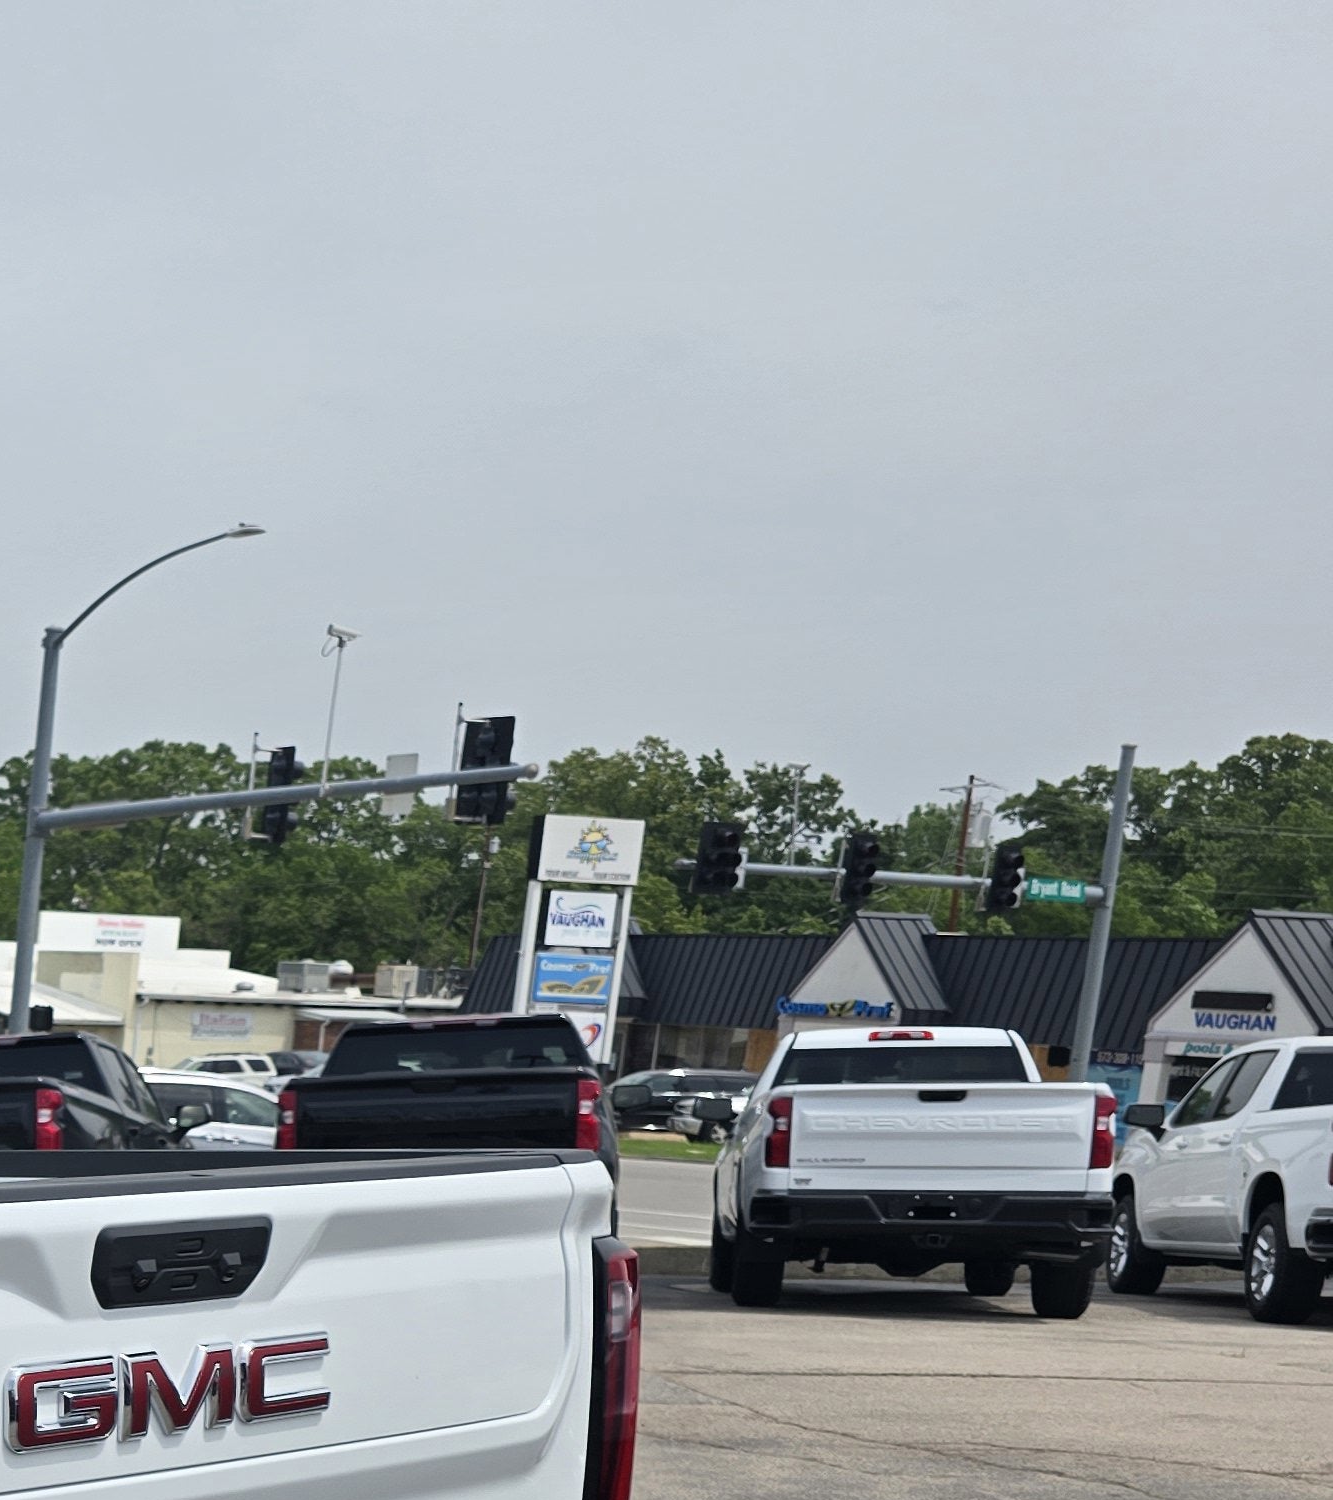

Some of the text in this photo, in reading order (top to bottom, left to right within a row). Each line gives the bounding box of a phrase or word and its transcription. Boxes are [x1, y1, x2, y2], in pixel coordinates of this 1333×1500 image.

[549, 909, 606, 929] VAUGHAN
[776, 996, 894, 1018] Cosmo Prof
[1194, 1012, 1277, 1031] VAUGHAN
[1184, 1042, 1221, 1055] pools
[810, 1114, 1075, 1132] CHEVROLET
[4, 1331, 331, 1453] GMC
